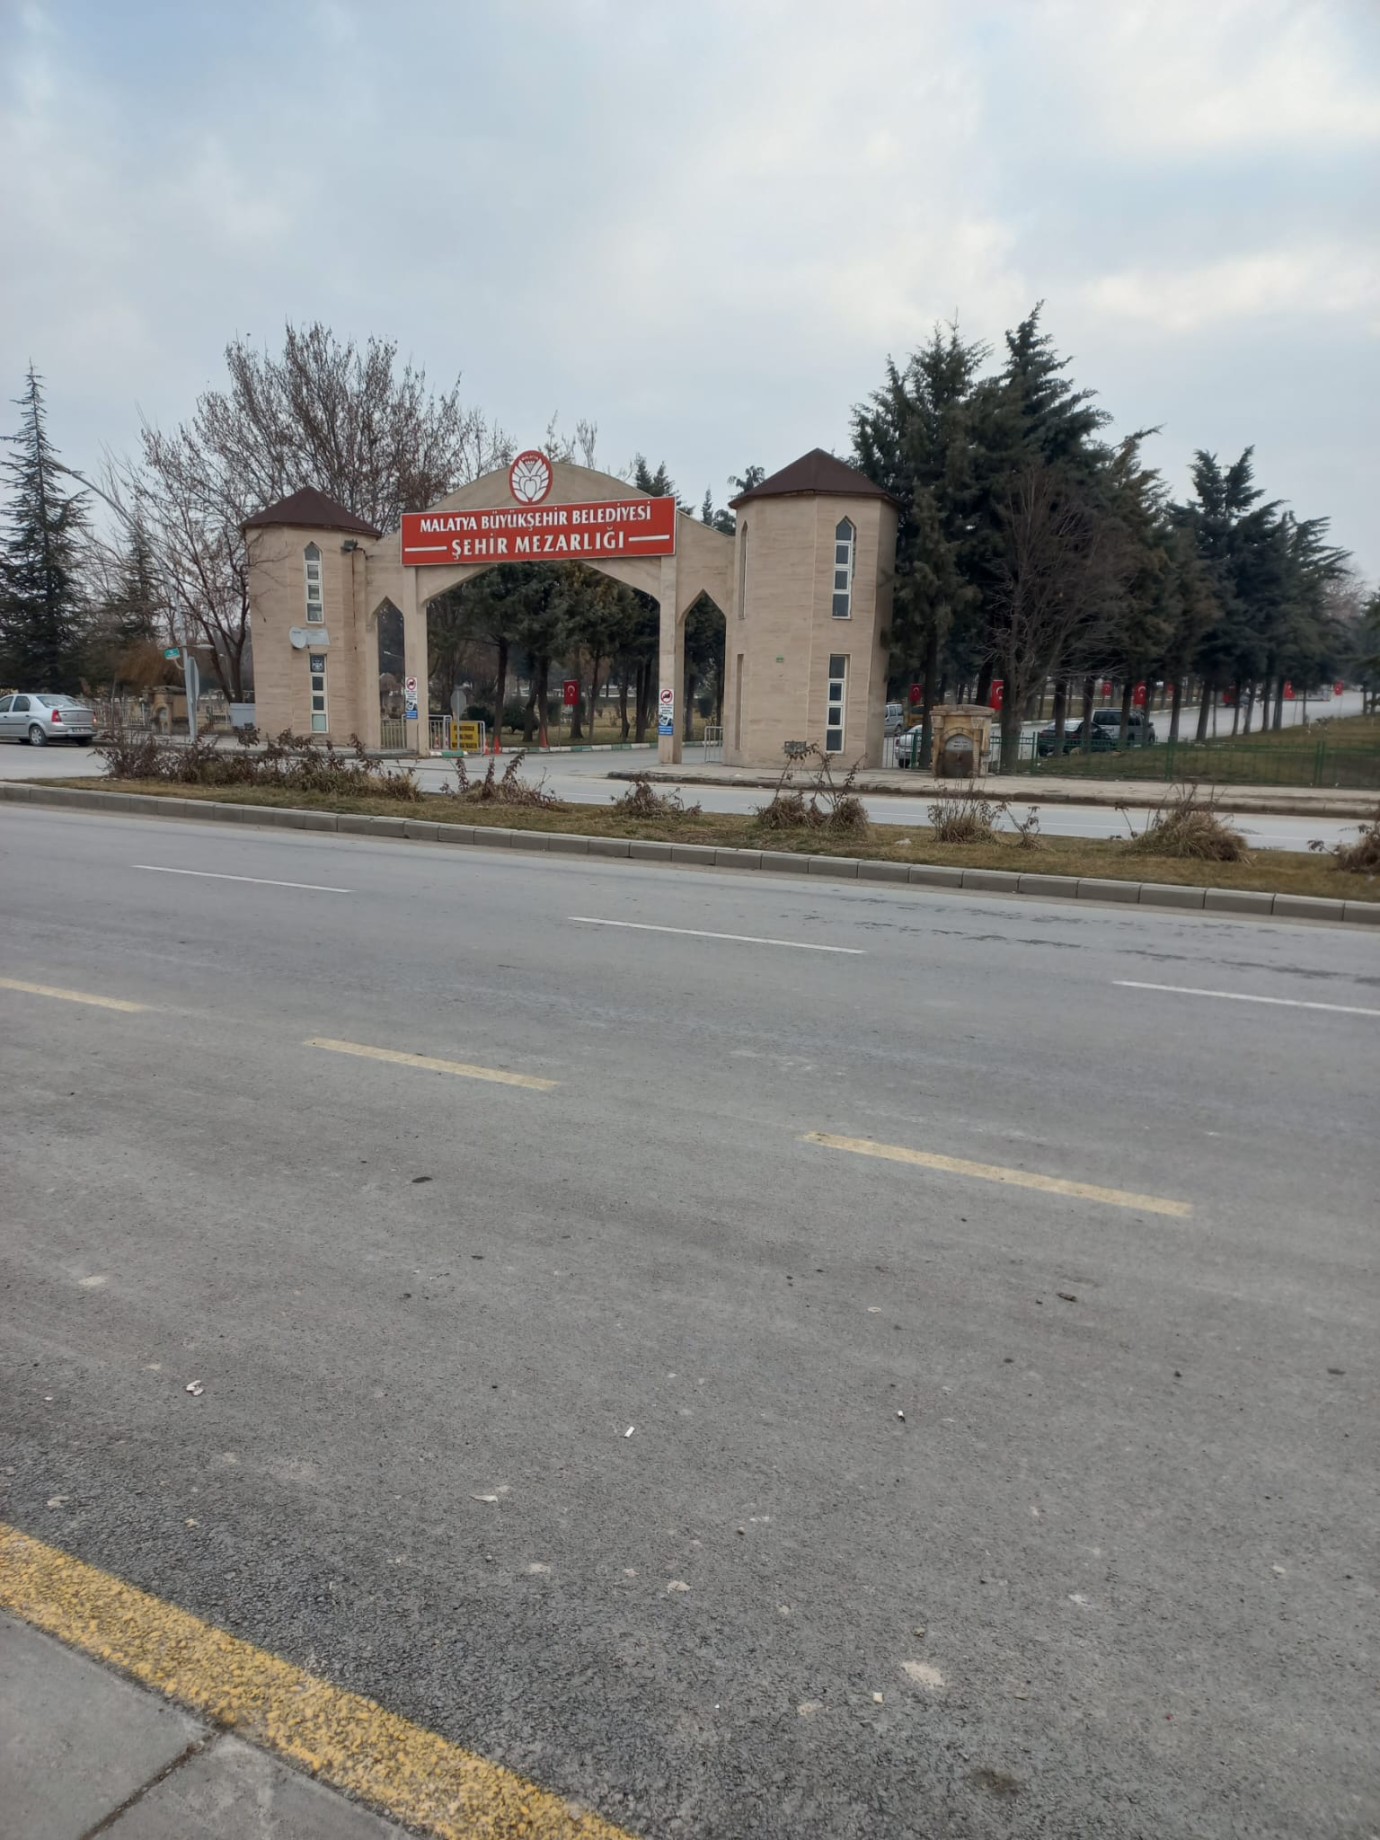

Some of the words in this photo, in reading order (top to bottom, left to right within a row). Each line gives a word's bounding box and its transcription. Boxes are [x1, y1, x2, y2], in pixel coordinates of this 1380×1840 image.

[420, 518, 477, 532] MALATYA
[481, 507, 567, 530] BÜYÜKŞEHİR
[572, 502, 651, 524] BELEDİYESİ
[452, 533, 508, 560] ŞEHİR
[515, 526, 624, 553] MEZARLIĞI
